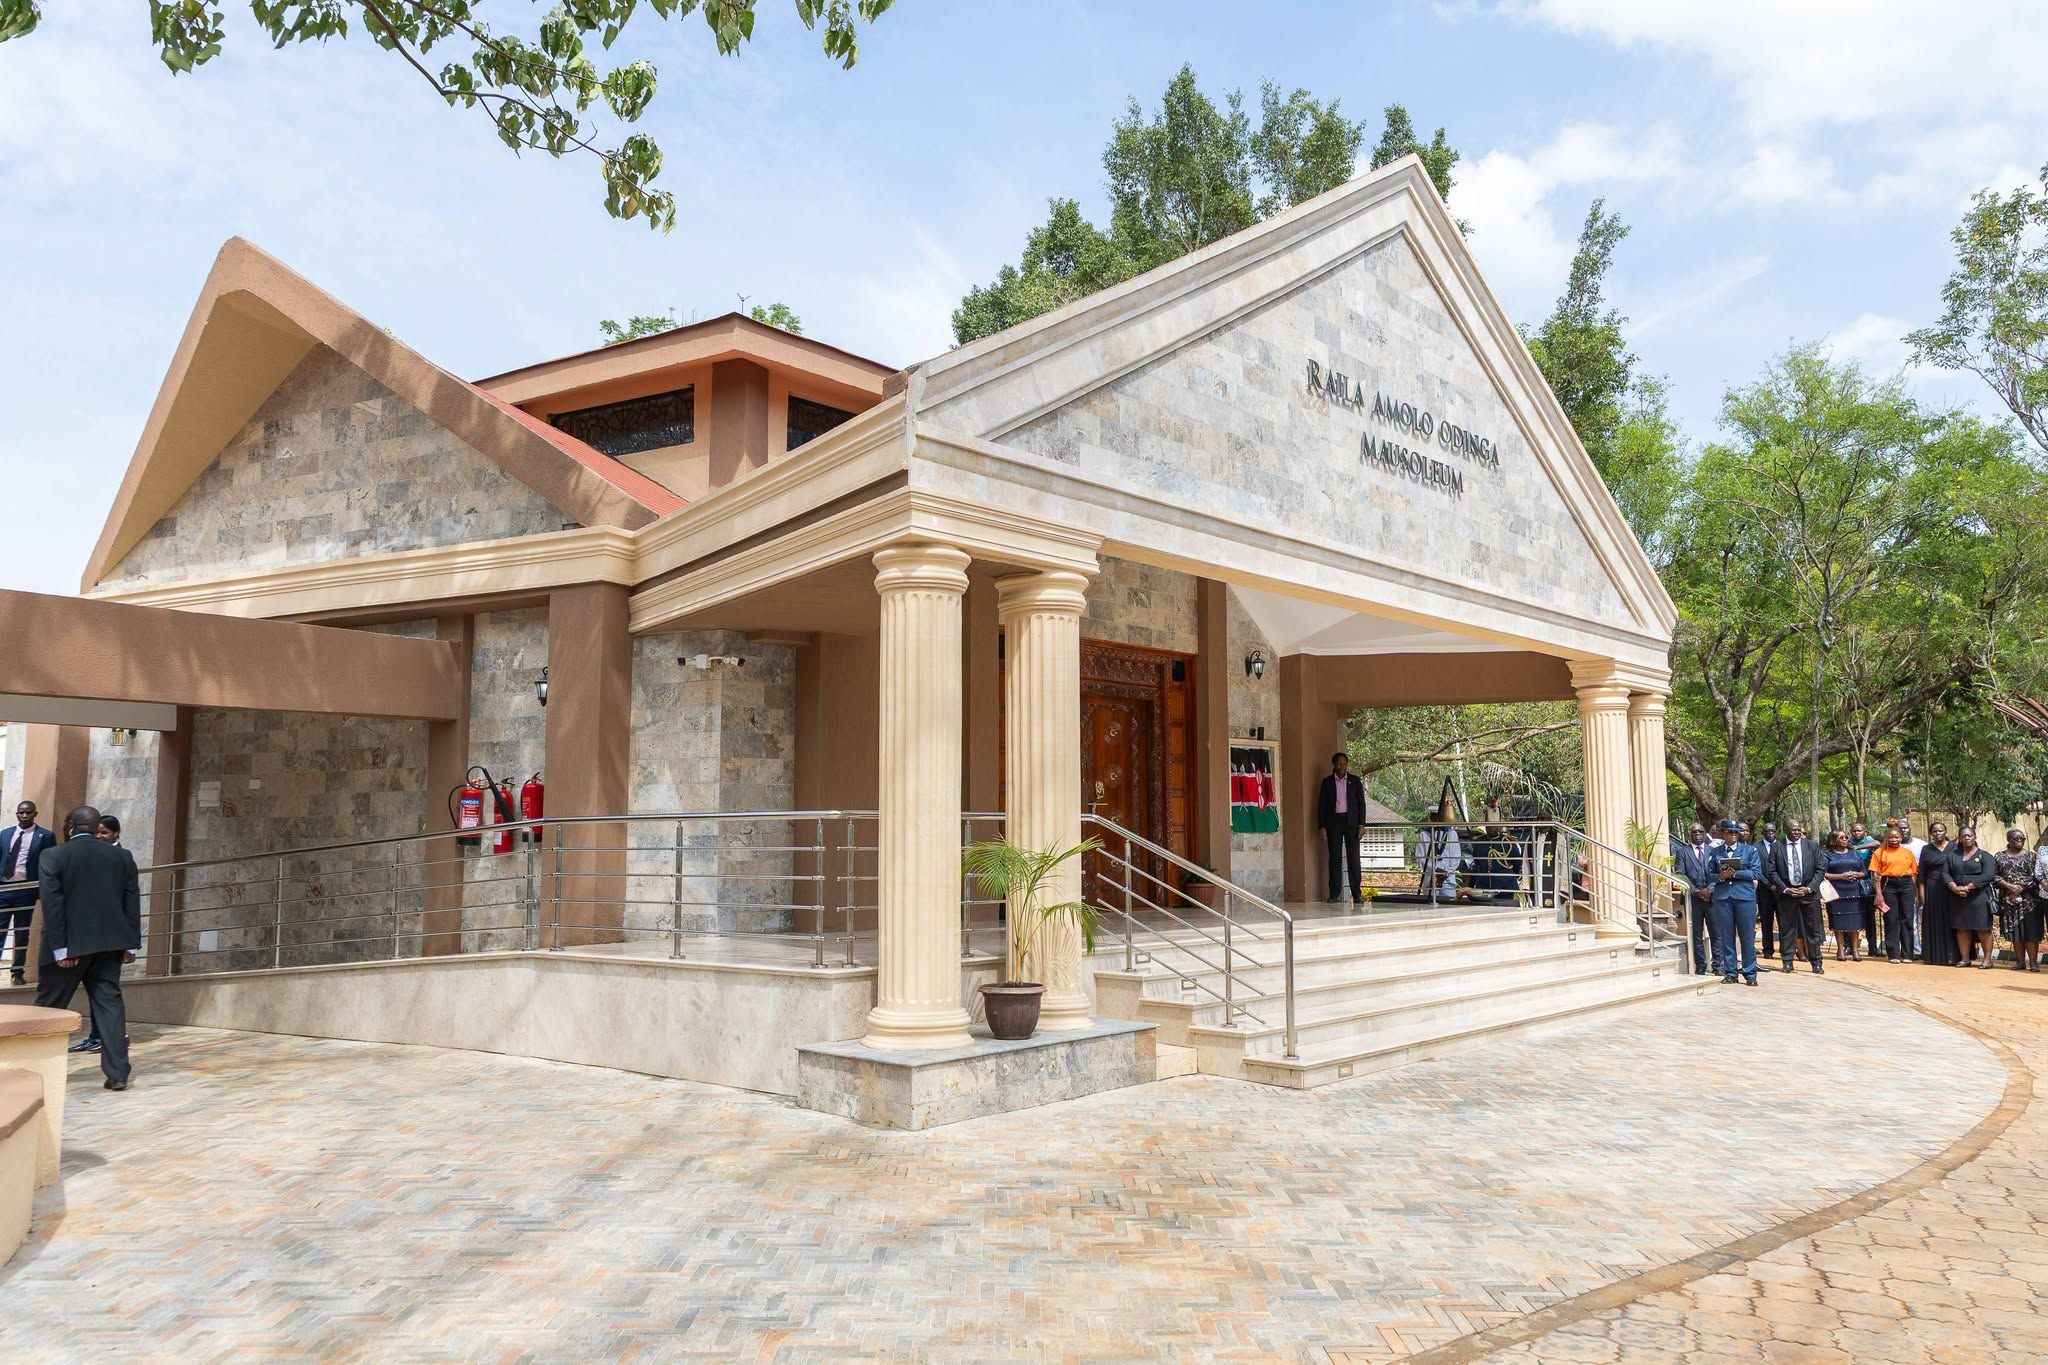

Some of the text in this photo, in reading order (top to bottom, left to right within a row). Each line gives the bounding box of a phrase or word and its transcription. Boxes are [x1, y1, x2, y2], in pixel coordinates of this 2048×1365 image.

[1307, 358, 1500, 466] RAILA AMOLO ODINGA
[1361, 431, 1464, 494] MAUSOLEUM
